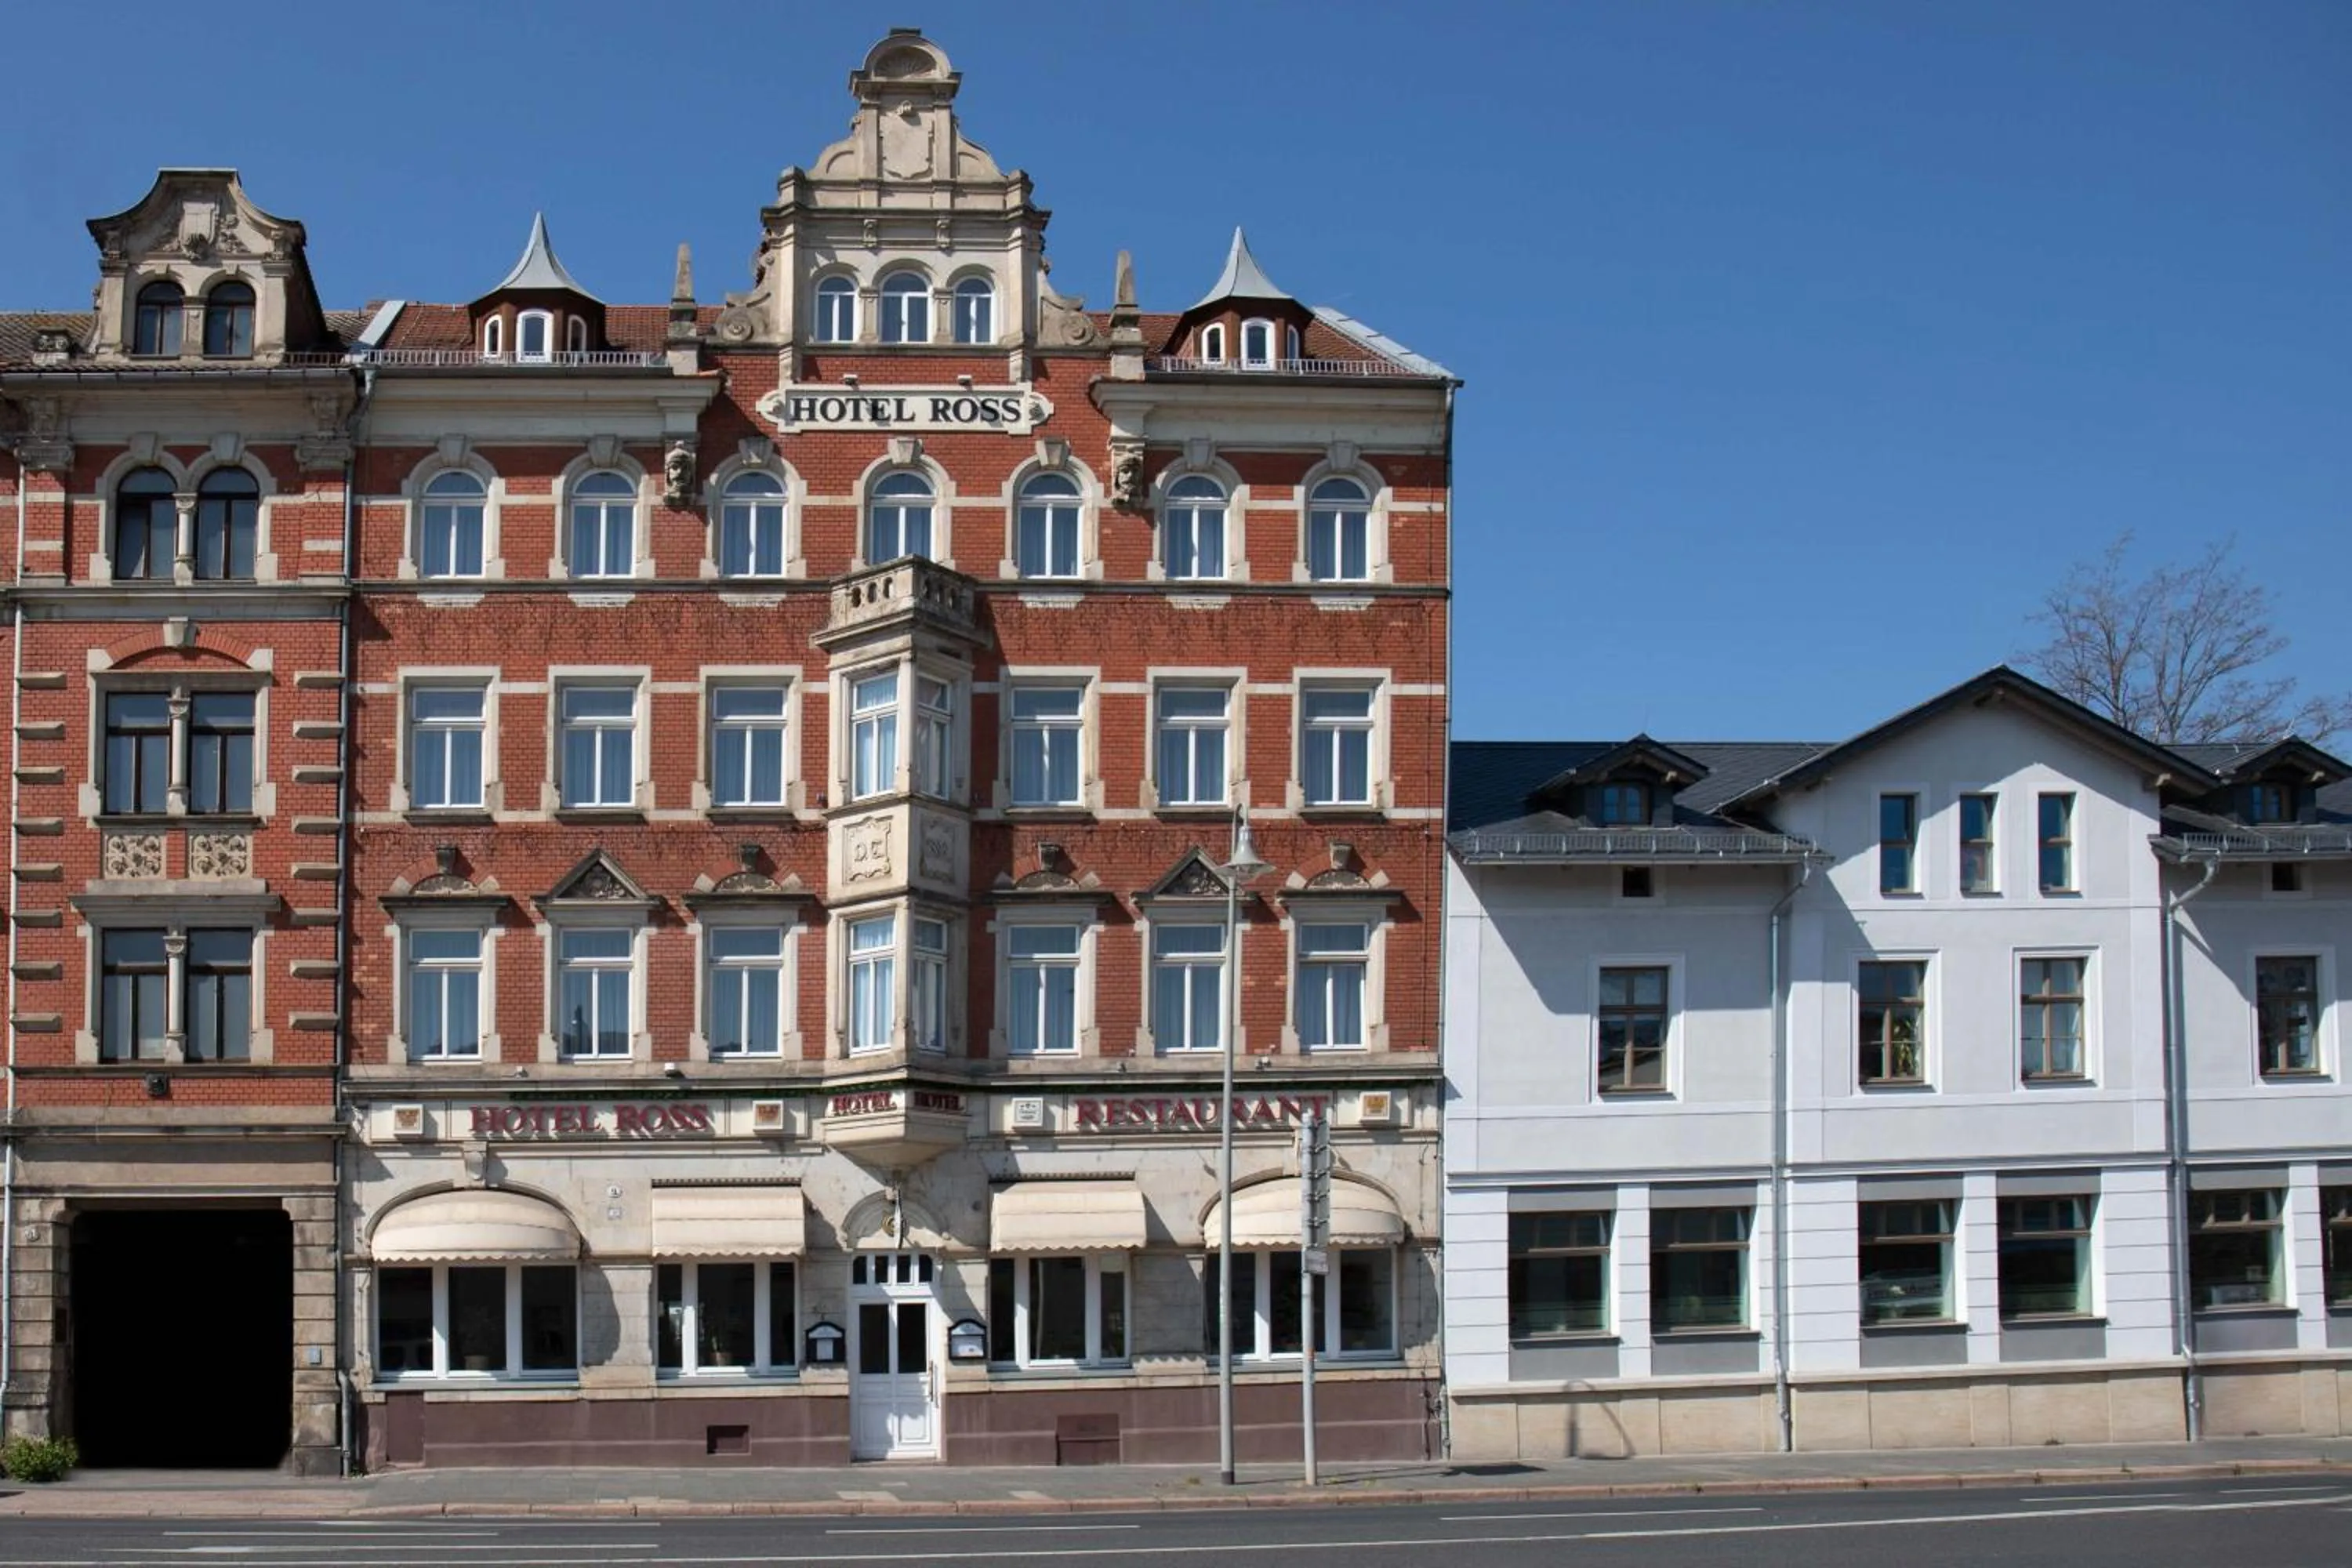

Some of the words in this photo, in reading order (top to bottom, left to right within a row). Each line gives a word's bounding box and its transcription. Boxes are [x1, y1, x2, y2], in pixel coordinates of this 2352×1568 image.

[790, 397, 916, 423] HOTEL
[928, 397, 1022, 423] ROSS
[833, 1091, 896, 1112] HOTEL
[914, 1091, 964, 1111] HOTEL
[1075, 1095, 1330, 1127] RESTAURANT
[470, 1104, 603, 1133] HOTEL
[614, 1102, 711, 1132] ROSS
